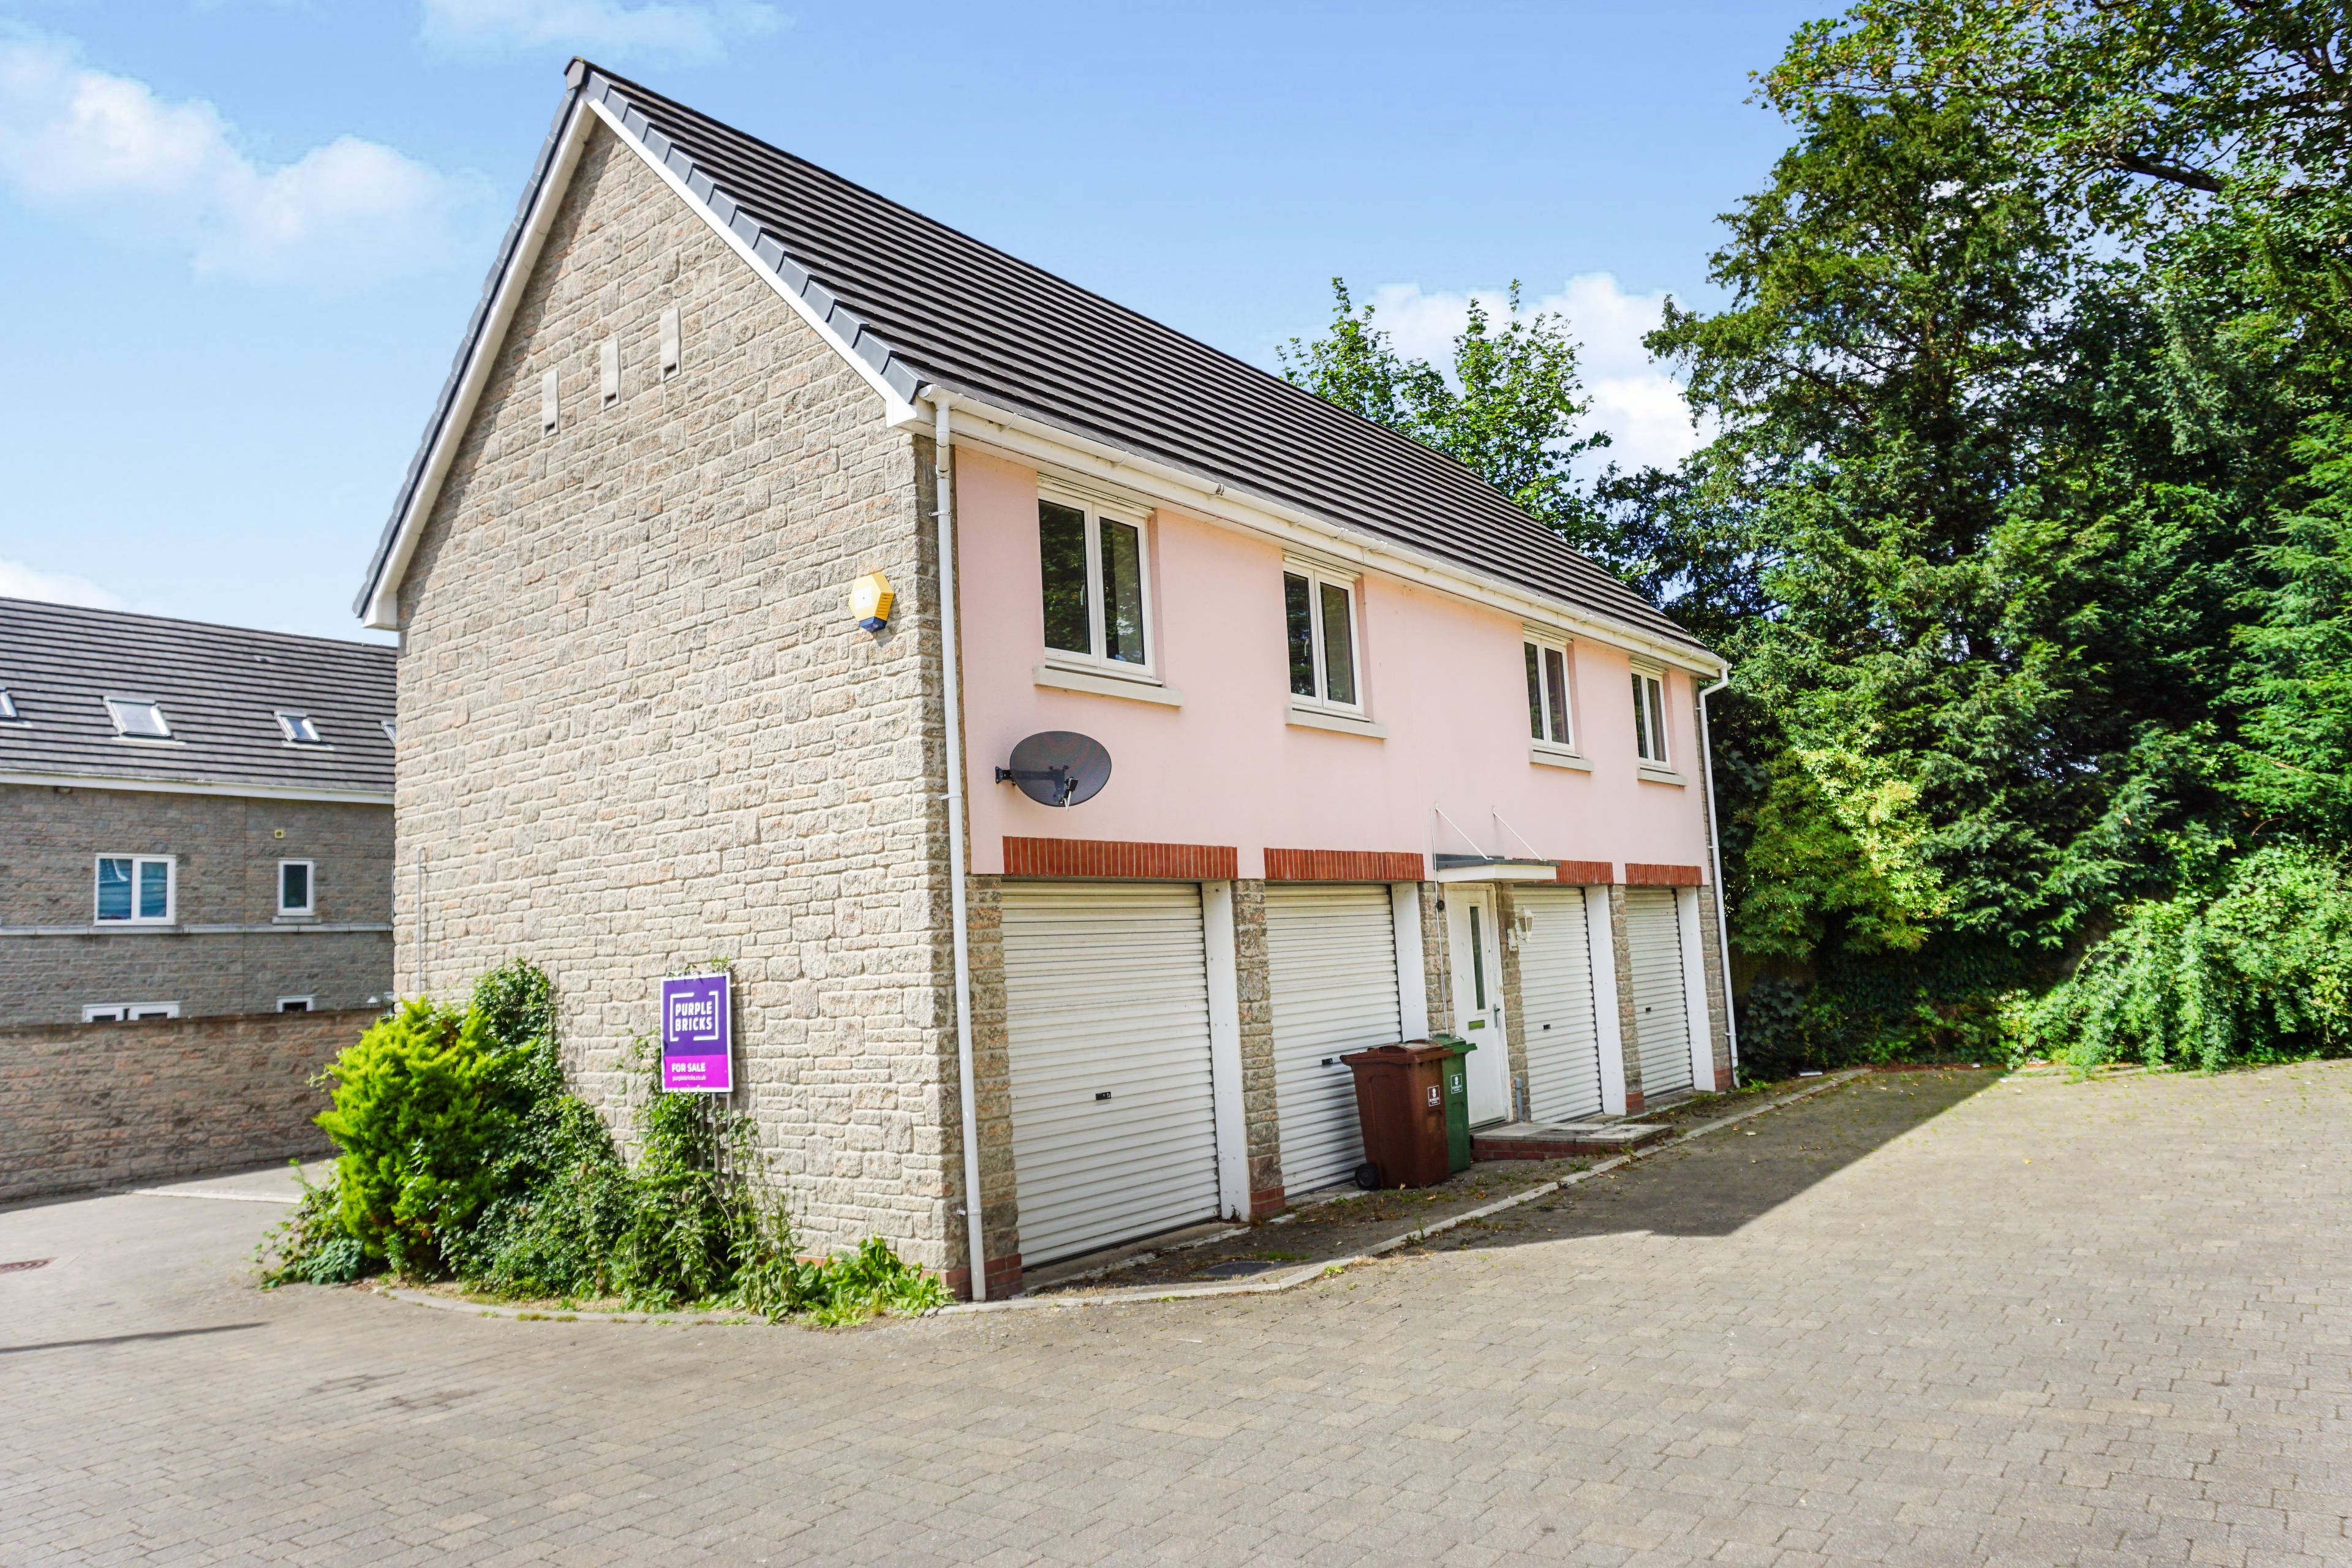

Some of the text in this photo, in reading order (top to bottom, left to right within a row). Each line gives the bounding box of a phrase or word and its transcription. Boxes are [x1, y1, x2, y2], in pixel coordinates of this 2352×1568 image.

[676, 1001, 712, 1016] PURPLE
[675, 1017, 712, 1031] BRICKS
[671, 1063, 706, 1072] FOR SALE
